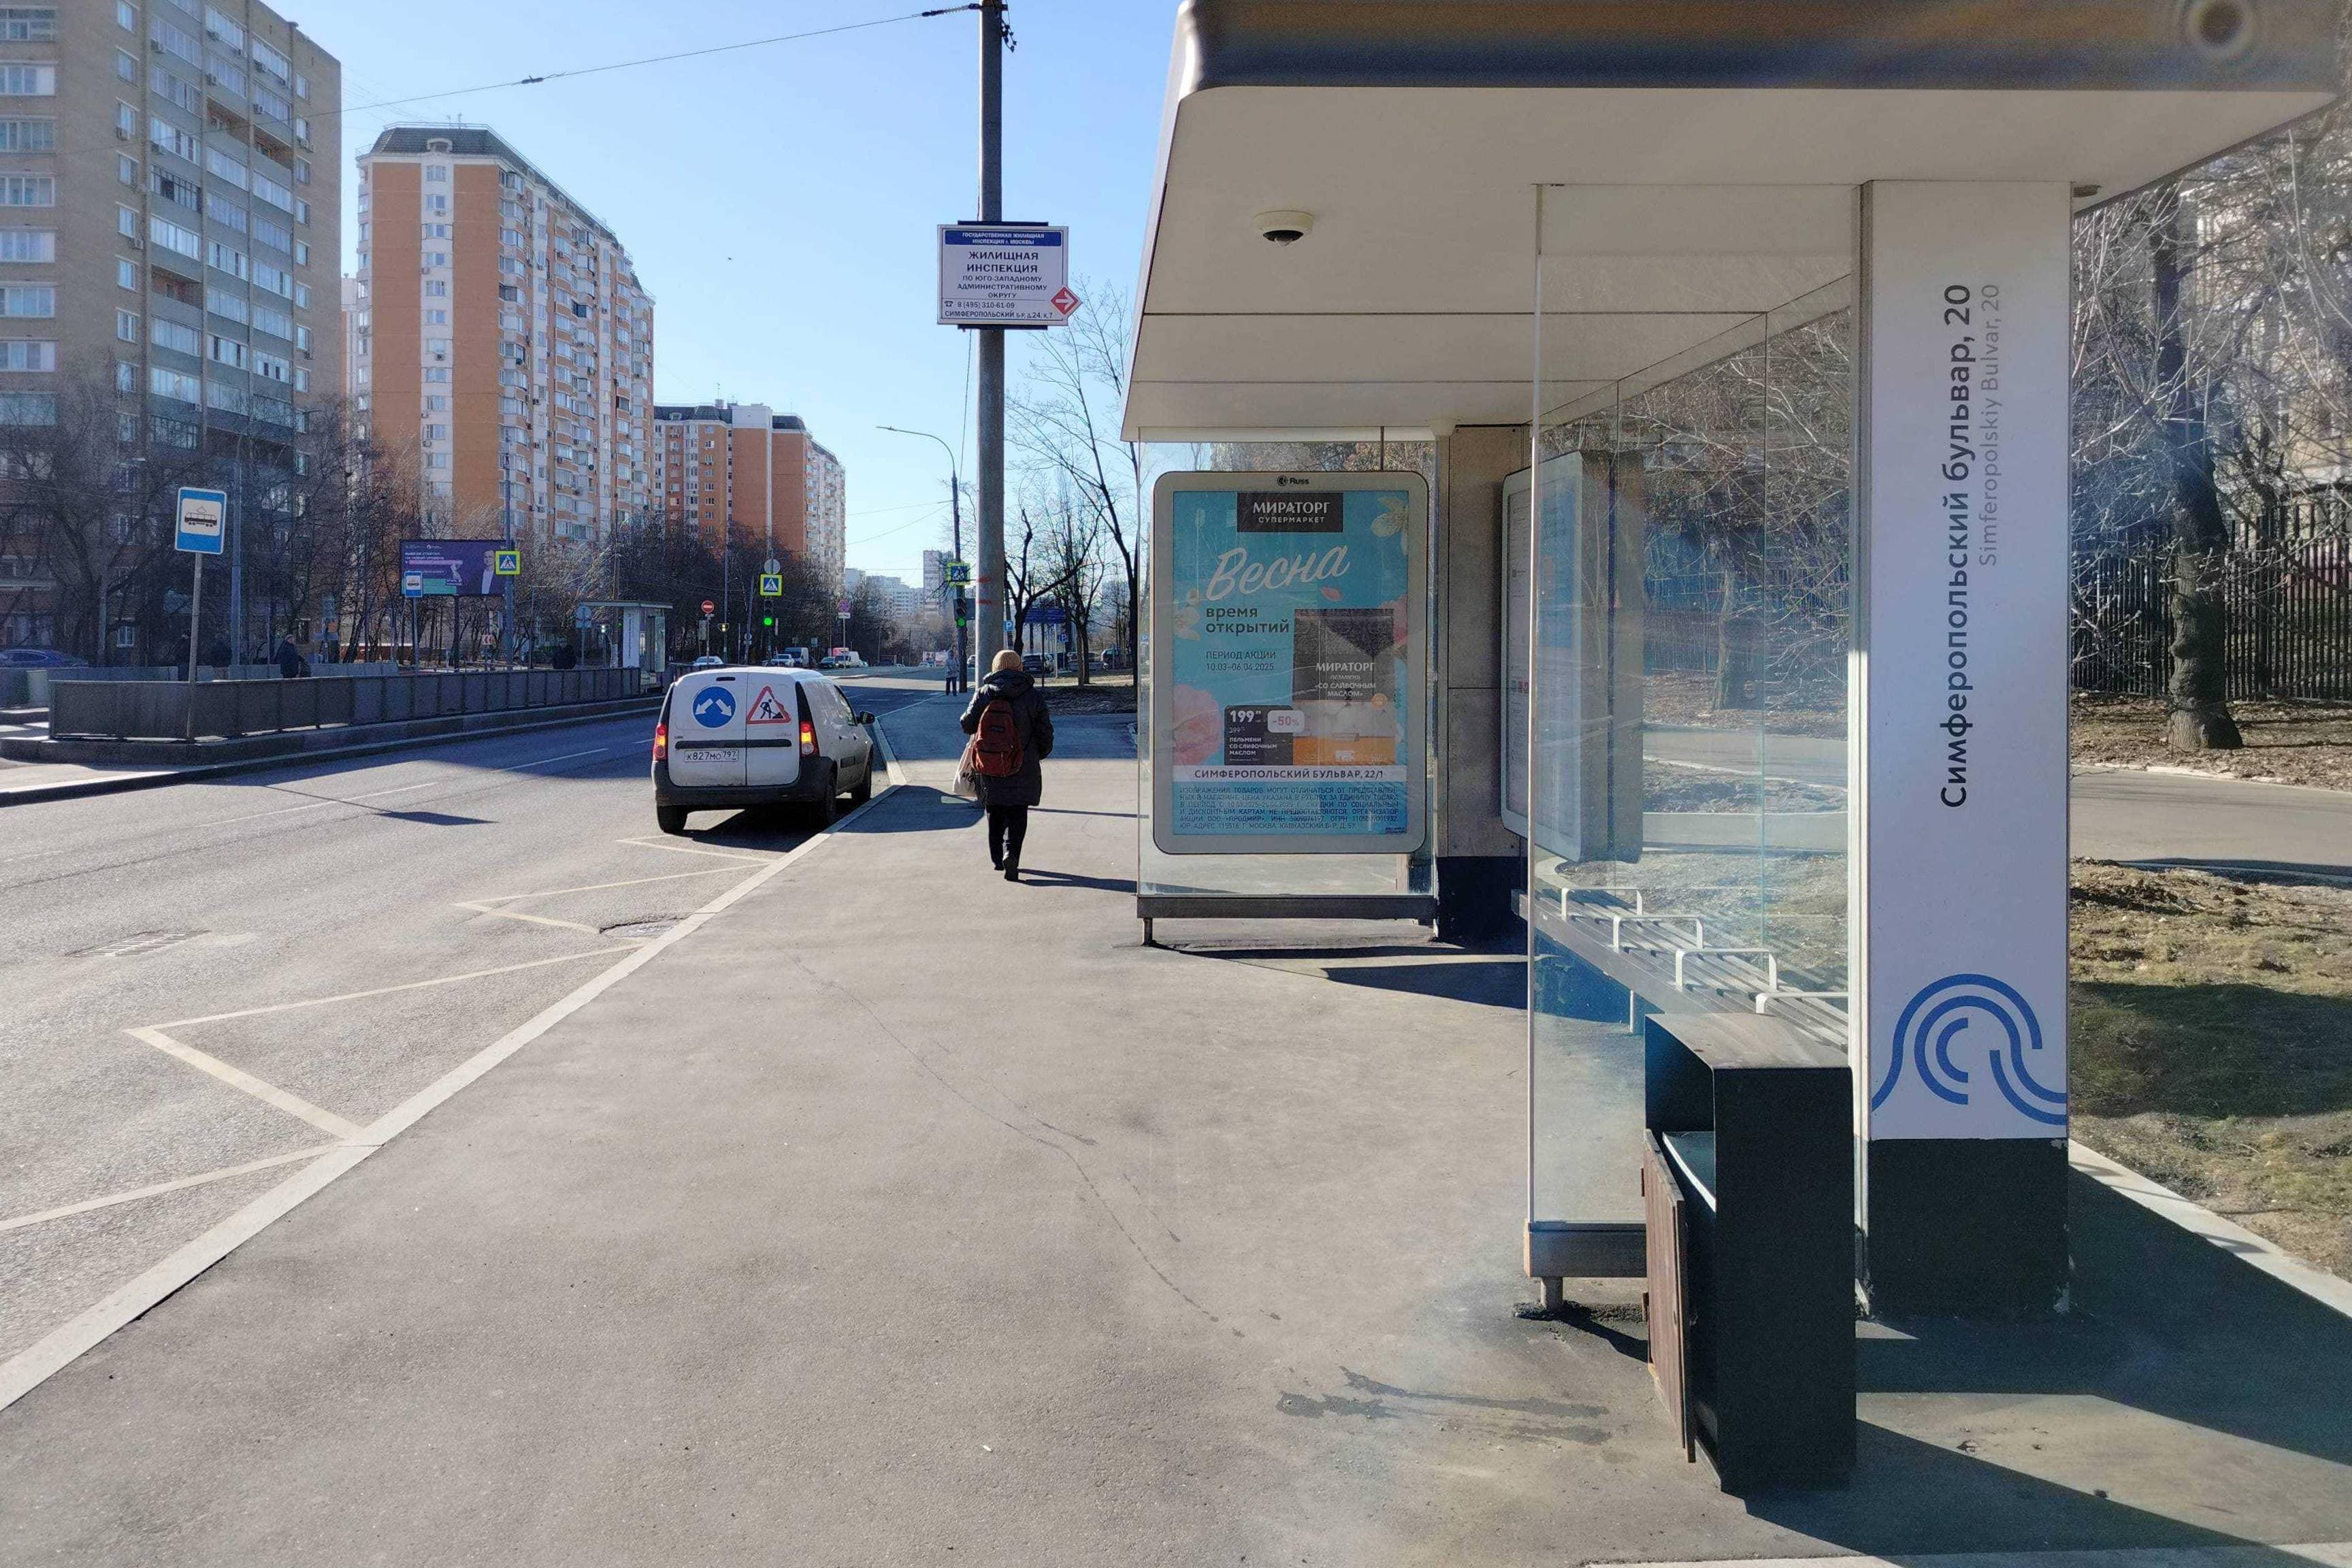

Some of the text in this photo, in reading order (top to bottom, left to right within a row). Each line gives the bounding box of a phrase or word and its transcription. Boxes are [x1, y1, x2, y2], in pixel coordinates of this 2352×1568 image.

[968, 251, 1039, 261] ЖИЛИЩНАЯ
[966, 263, 1038, 274] ИНСПЕКЦИЯ
[945, 309, 1015, 318] СИМФЕРОПОЛЬСКИЙ
[1978, 284, 2003, 566] Simferopolskiy Bulvar, 20
[1252, 502, 1330, 514] МИРАТОРГ
[1940, 284, 1976, 808] Симферопольский бульвар, 20
[1205, 545, 1351, 601] Весна
[1206, 608, 1258, 621] время
[1206, 619, 1290, 636] открытий
[1206, 651, 1276, 660] ПЕРИОД АКЦИИ
[1316, 662, 1375, 672] МИРАТОРГ
[1194, 768, 1384, 780] СИМФЕРОПОЛЬСКИЙ БУЛЬВАР, 22/1
